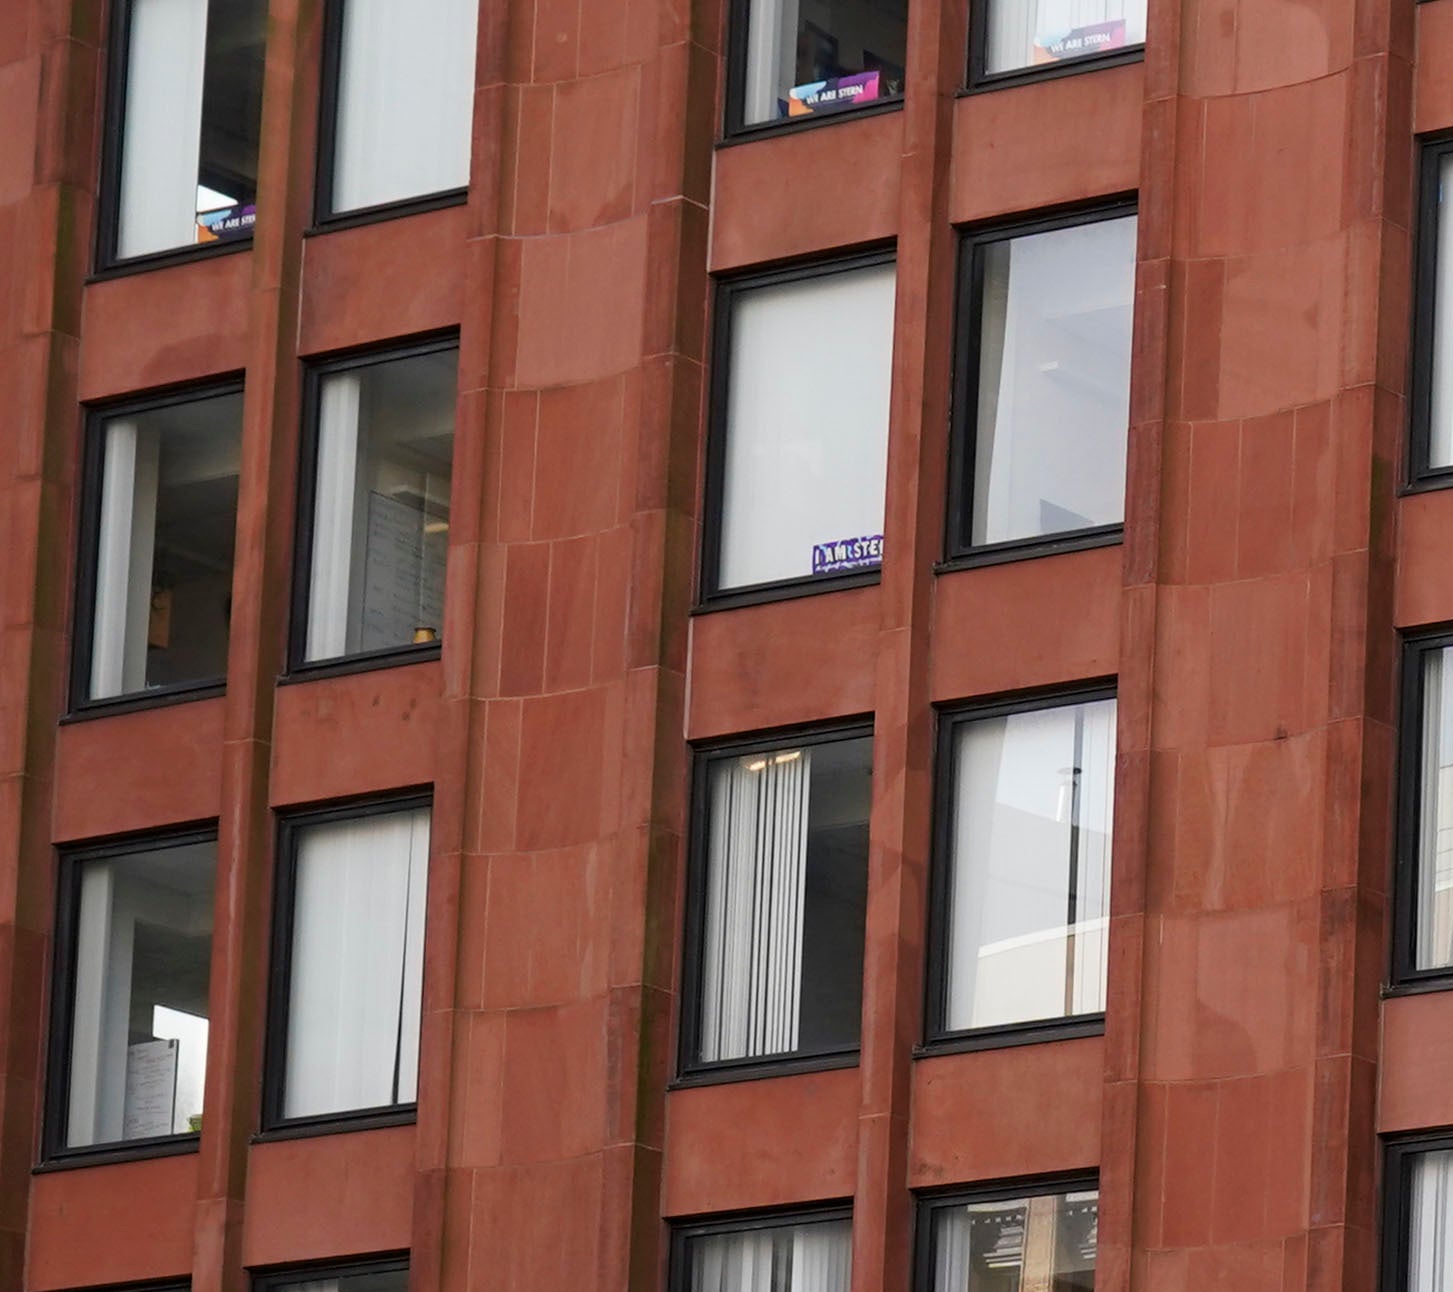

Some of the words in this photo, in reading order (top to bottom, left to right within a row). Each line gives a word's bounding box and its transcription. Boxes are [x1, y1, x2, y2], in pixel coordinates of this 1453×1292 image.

[1065, 39, 1083, 49] ARE
[1084, 32, 1111, 45] STERN
[806, 93, 819, 105] WE
[820, 89, 837, 101] ARE
[838, 84, 863, 98] STERN
[225, 218, 239, 229] ARE
[826, 544, 847, 562] AM
[854, 540, 884, 558] STE
